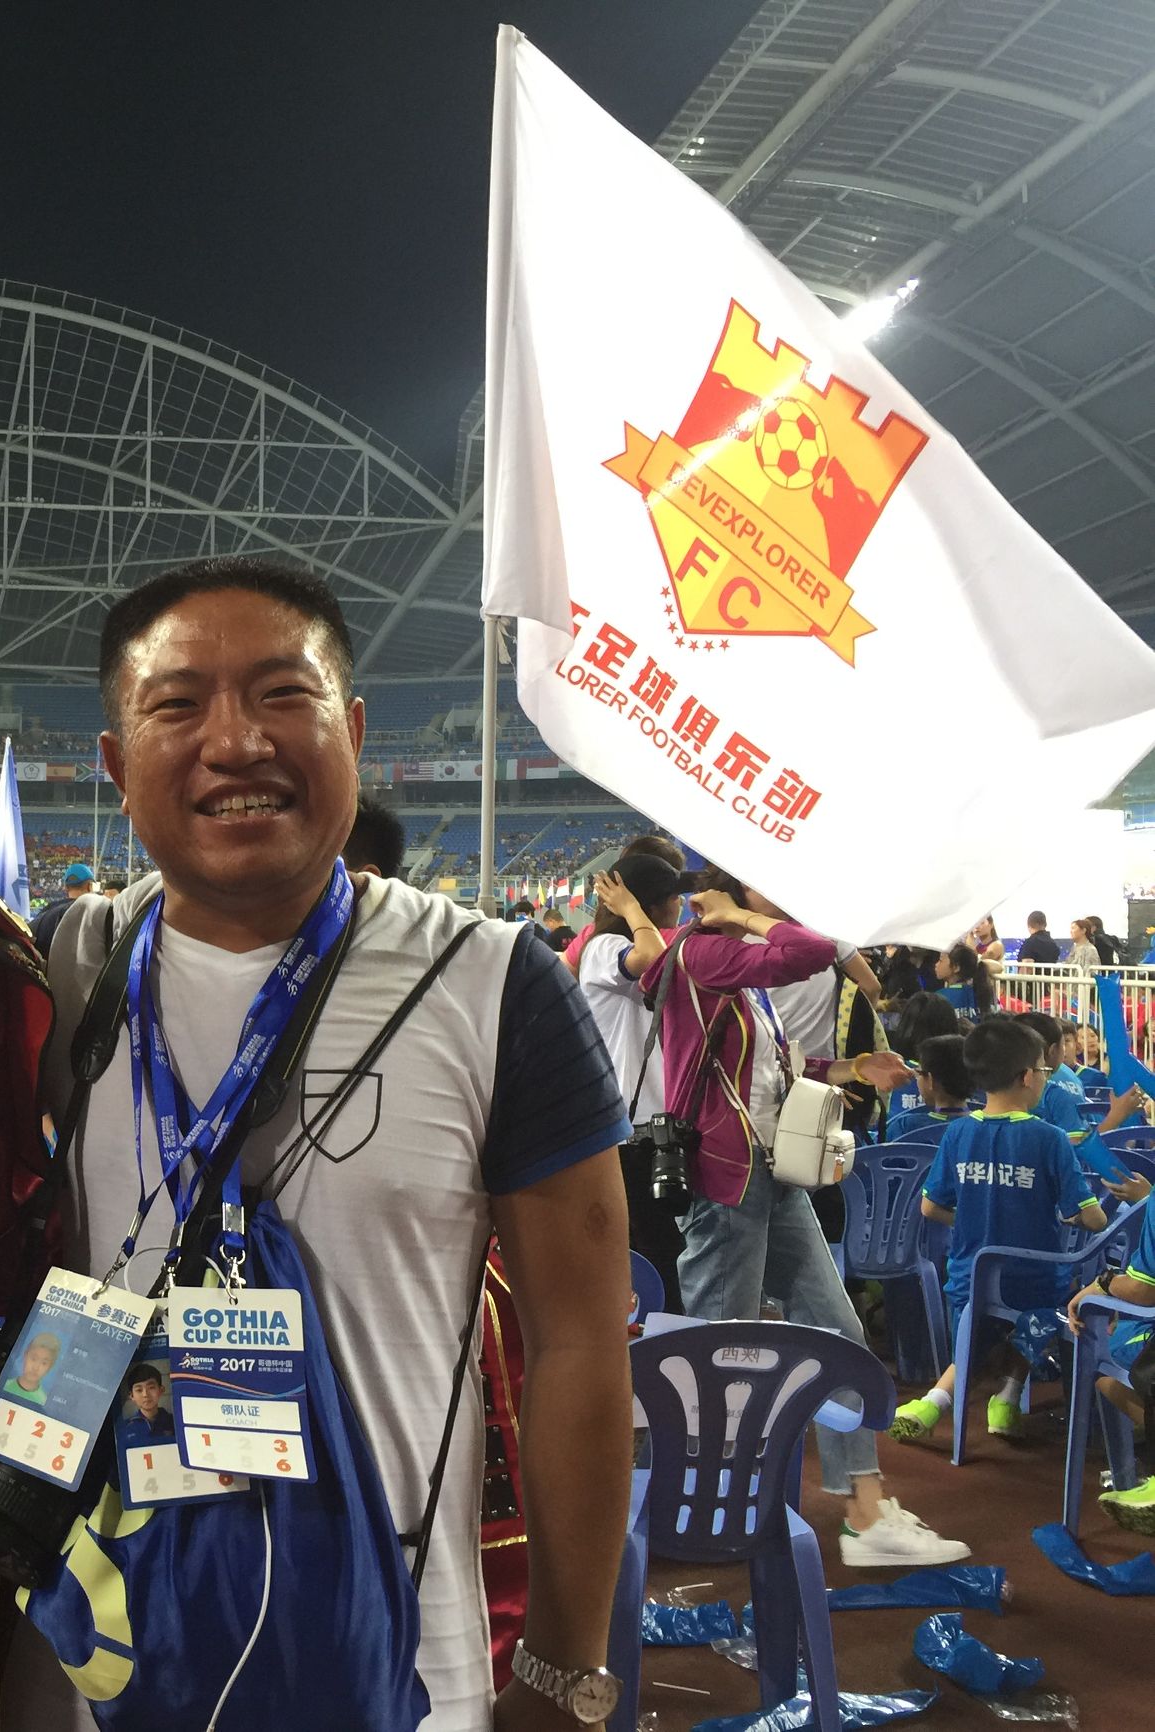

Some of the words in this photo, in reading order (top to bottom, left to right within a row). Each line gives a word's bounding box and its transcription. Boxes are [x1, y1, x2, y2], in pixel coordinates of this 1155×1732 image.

[628, 705, 726, 802] FOOTBALL
[731, 795, 796, 843] CLUB
[45, 1294, 61, 1304] CUP
[61, 1298, 85, 1312] CHINA
[49, 1285, 88, 1305] GOTHIA
[39, 1304, 62, 1317] 2017
[97, 1304, 141, 1330] 参赛证
[183, 1308, 289, 1329] GOTHIA
[90, 1321, 133, 1344] PLAYER
[183, 1328, 222, 1343] CUP
[226, 1330, 290, 1345] CHINA
[219, 1358, 255, 1372] 2017
[221, 1403, 260, 1417] 领队证
[6, 1409, 16, 1426] 1
[31, 1421, 47, 1439] 2
[60, 1431, 74, 1449] 3
[226, 1418, 258, 1427] COACH
[201, 1434, 211, 1447] 1
[273, 1439, 288, 1453] 3
[24, 1444, 38, 1460] 5
[51, 1454, 65, 1471] 6
[143, 1453, 153, 1470] 1
[276, 1459, 292, 1473] 6
[143, 1477, 158, 1494] 4
[182, 1474, 196, 1491] 5
